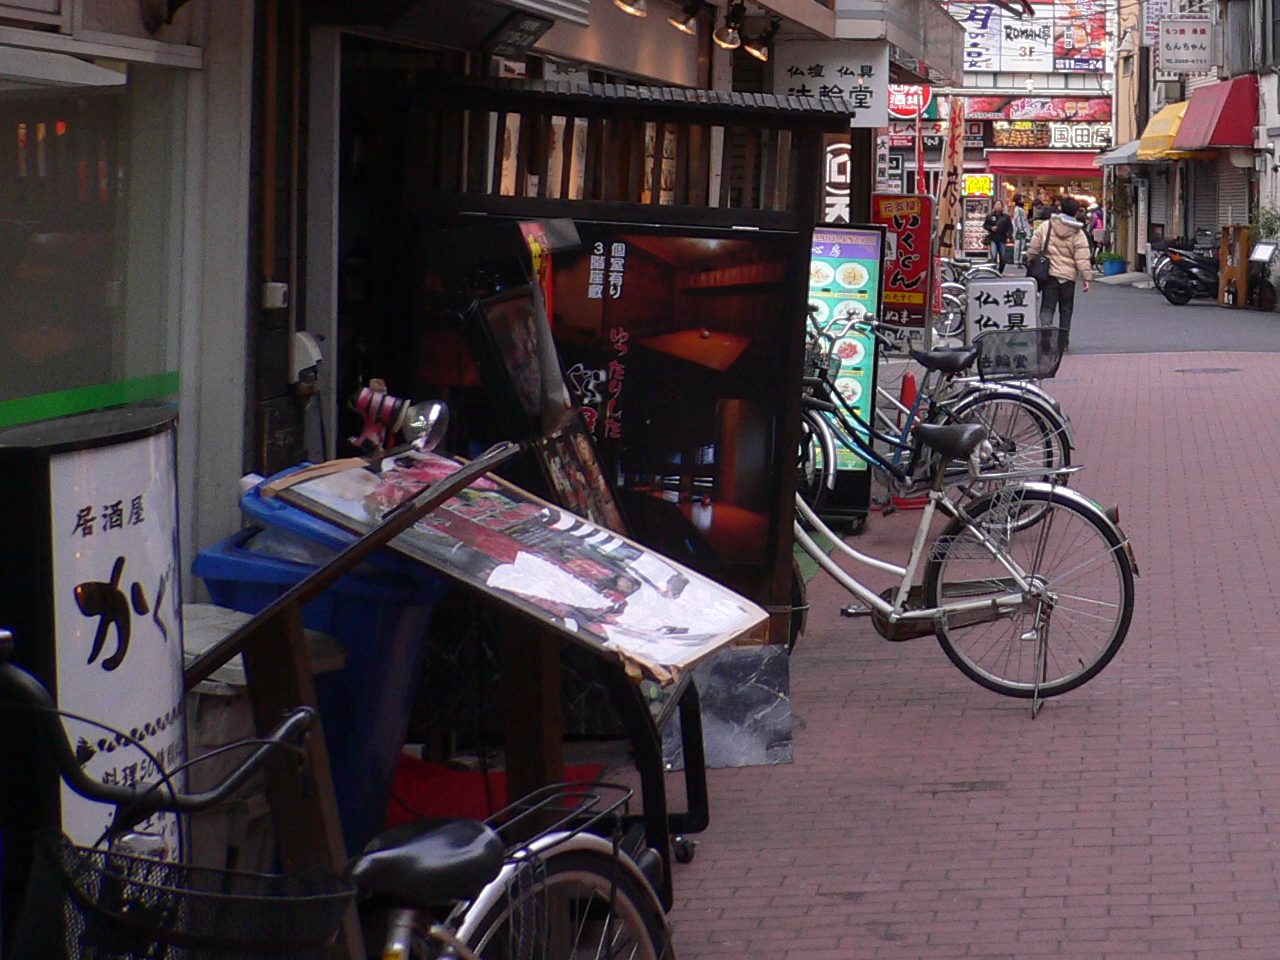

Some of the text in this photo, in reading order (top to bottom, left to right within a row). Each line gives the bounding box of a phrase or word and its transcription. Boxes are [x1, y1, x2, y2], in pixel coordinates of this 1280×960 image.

[1019, 46, 1036, 58] 3F
[837, 65, 875, 78] 仏具
[890, 213, 927, 290] いくどん
[609, 242, 626, 299] 個室有り
[974, 288, 1029, 308] 仏壇
[974, 313, 1029, 331] 仏具
[71, 495, 146, 537] 居酒屋
